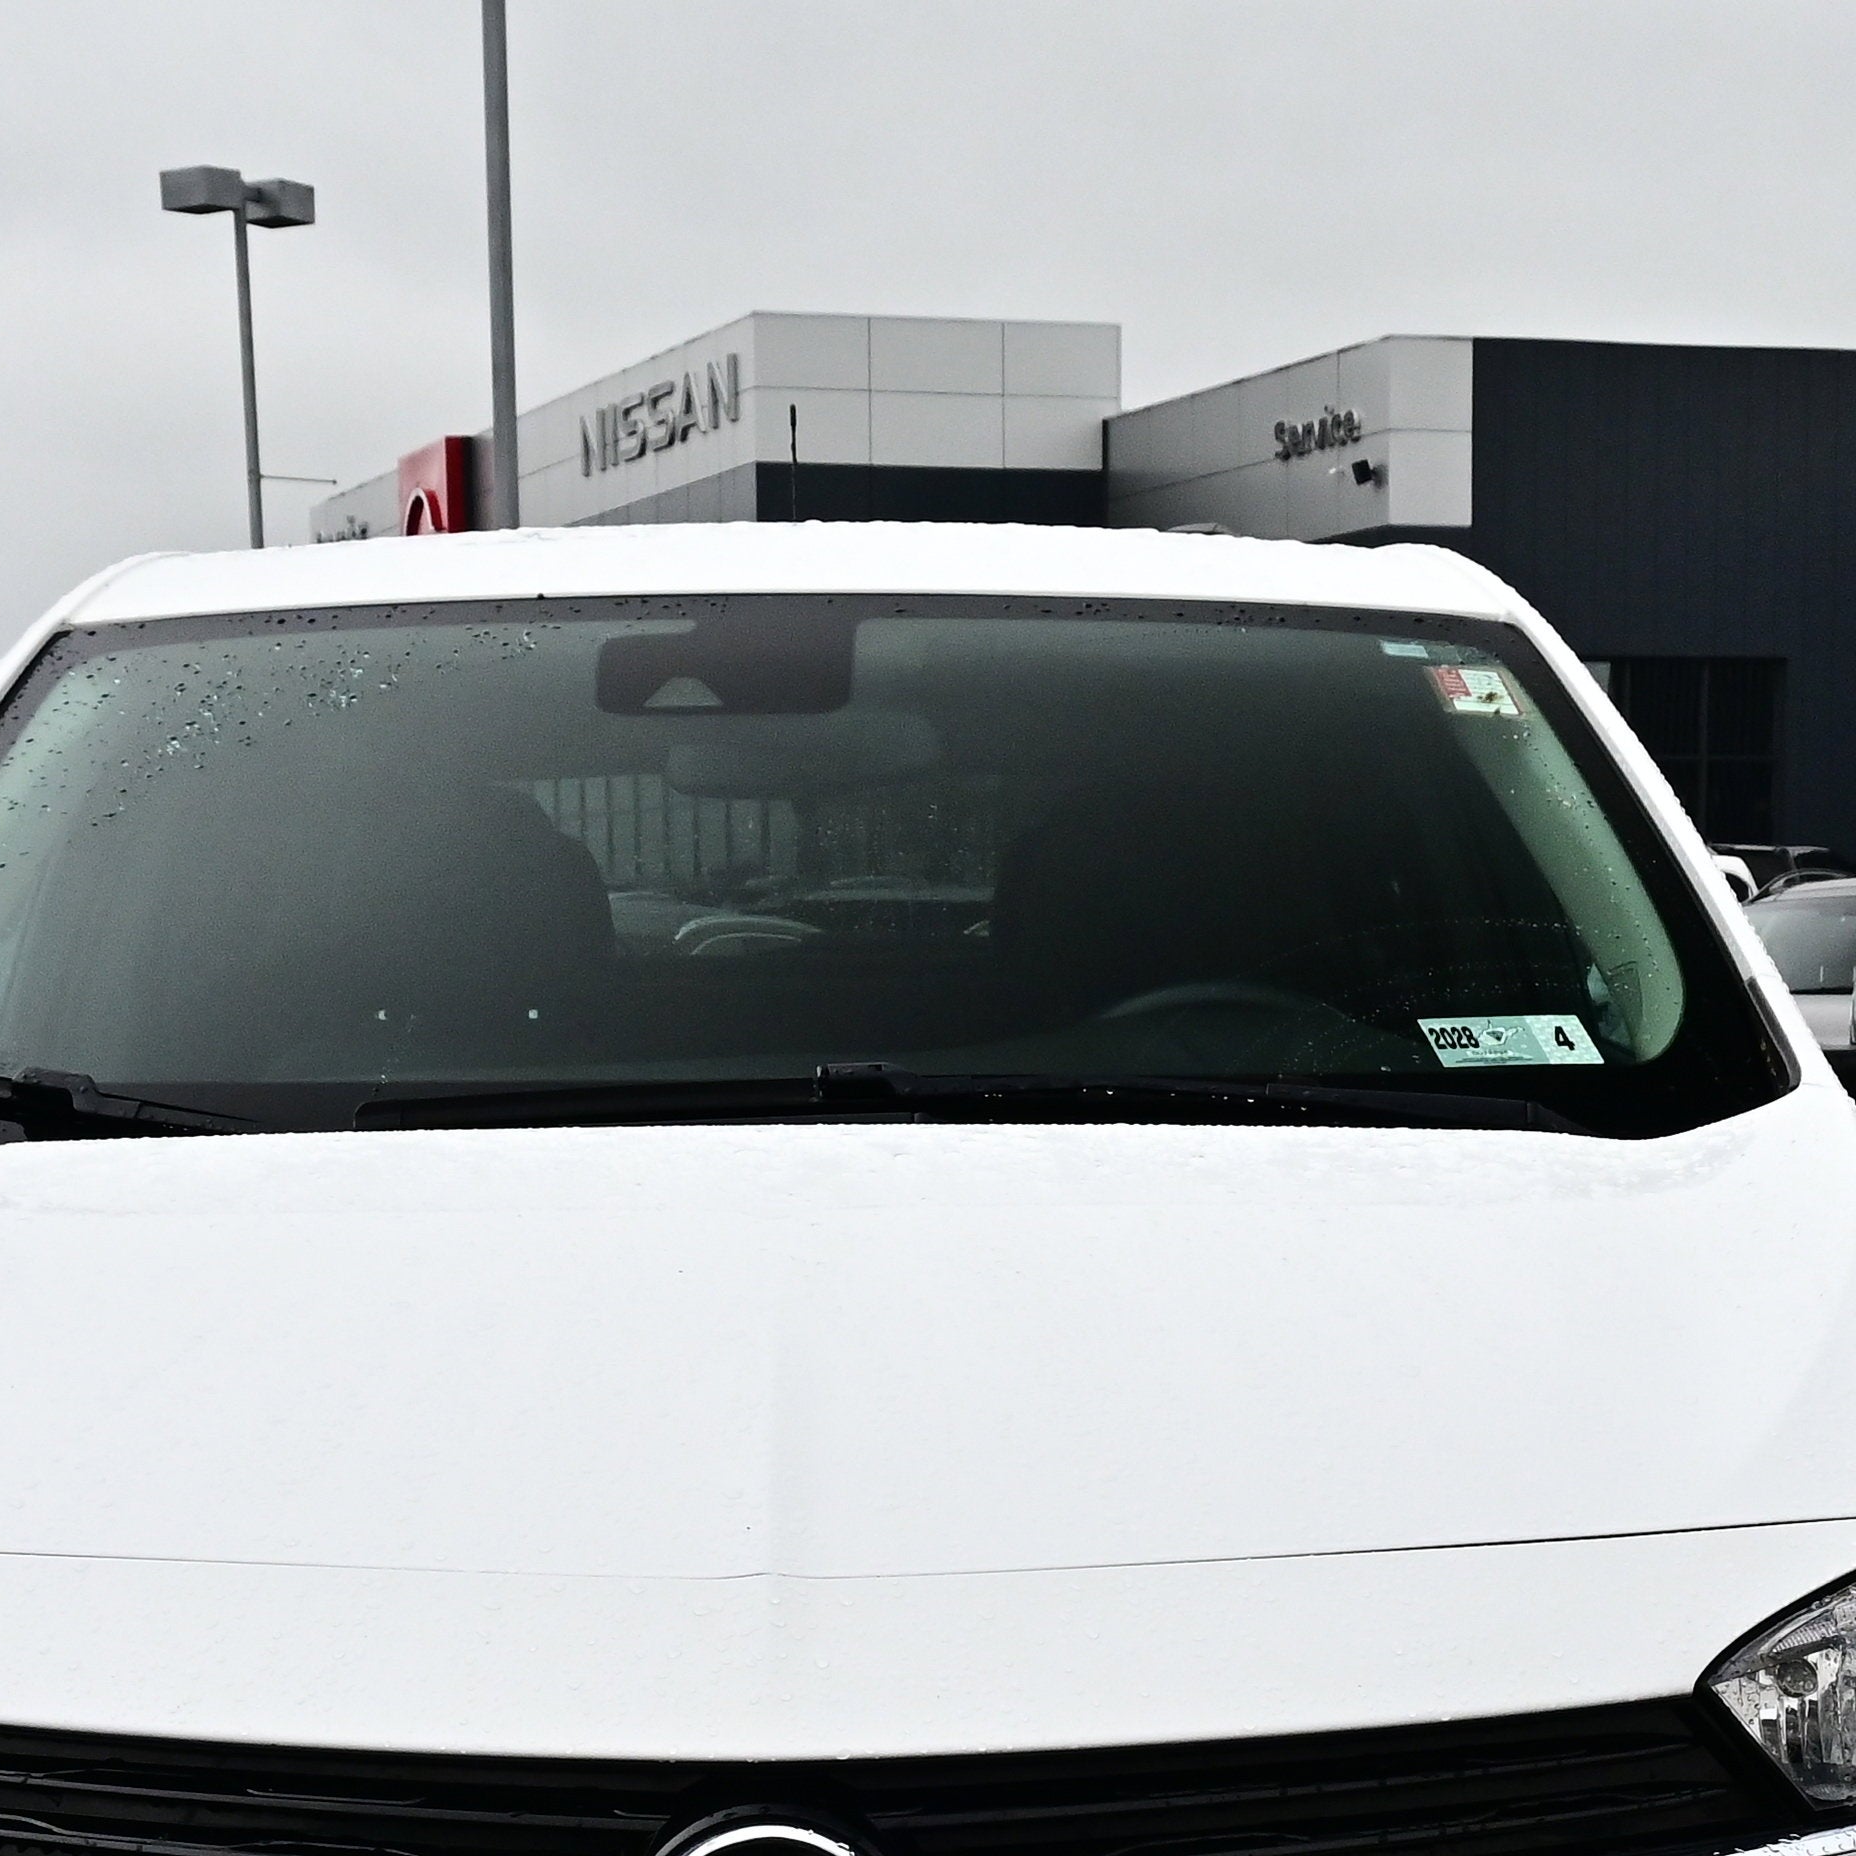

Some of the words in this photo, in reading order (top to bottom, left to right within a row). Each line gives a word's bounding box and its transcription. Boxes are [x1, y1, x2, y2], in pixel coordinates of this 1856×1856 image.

[579, 352, 741, 477] NISSAN
[1274, 403, 1361, 461] Service
[1428, 1026, 1480, 1050] 2028
[1554, 1025, 1576, 1051] 4
